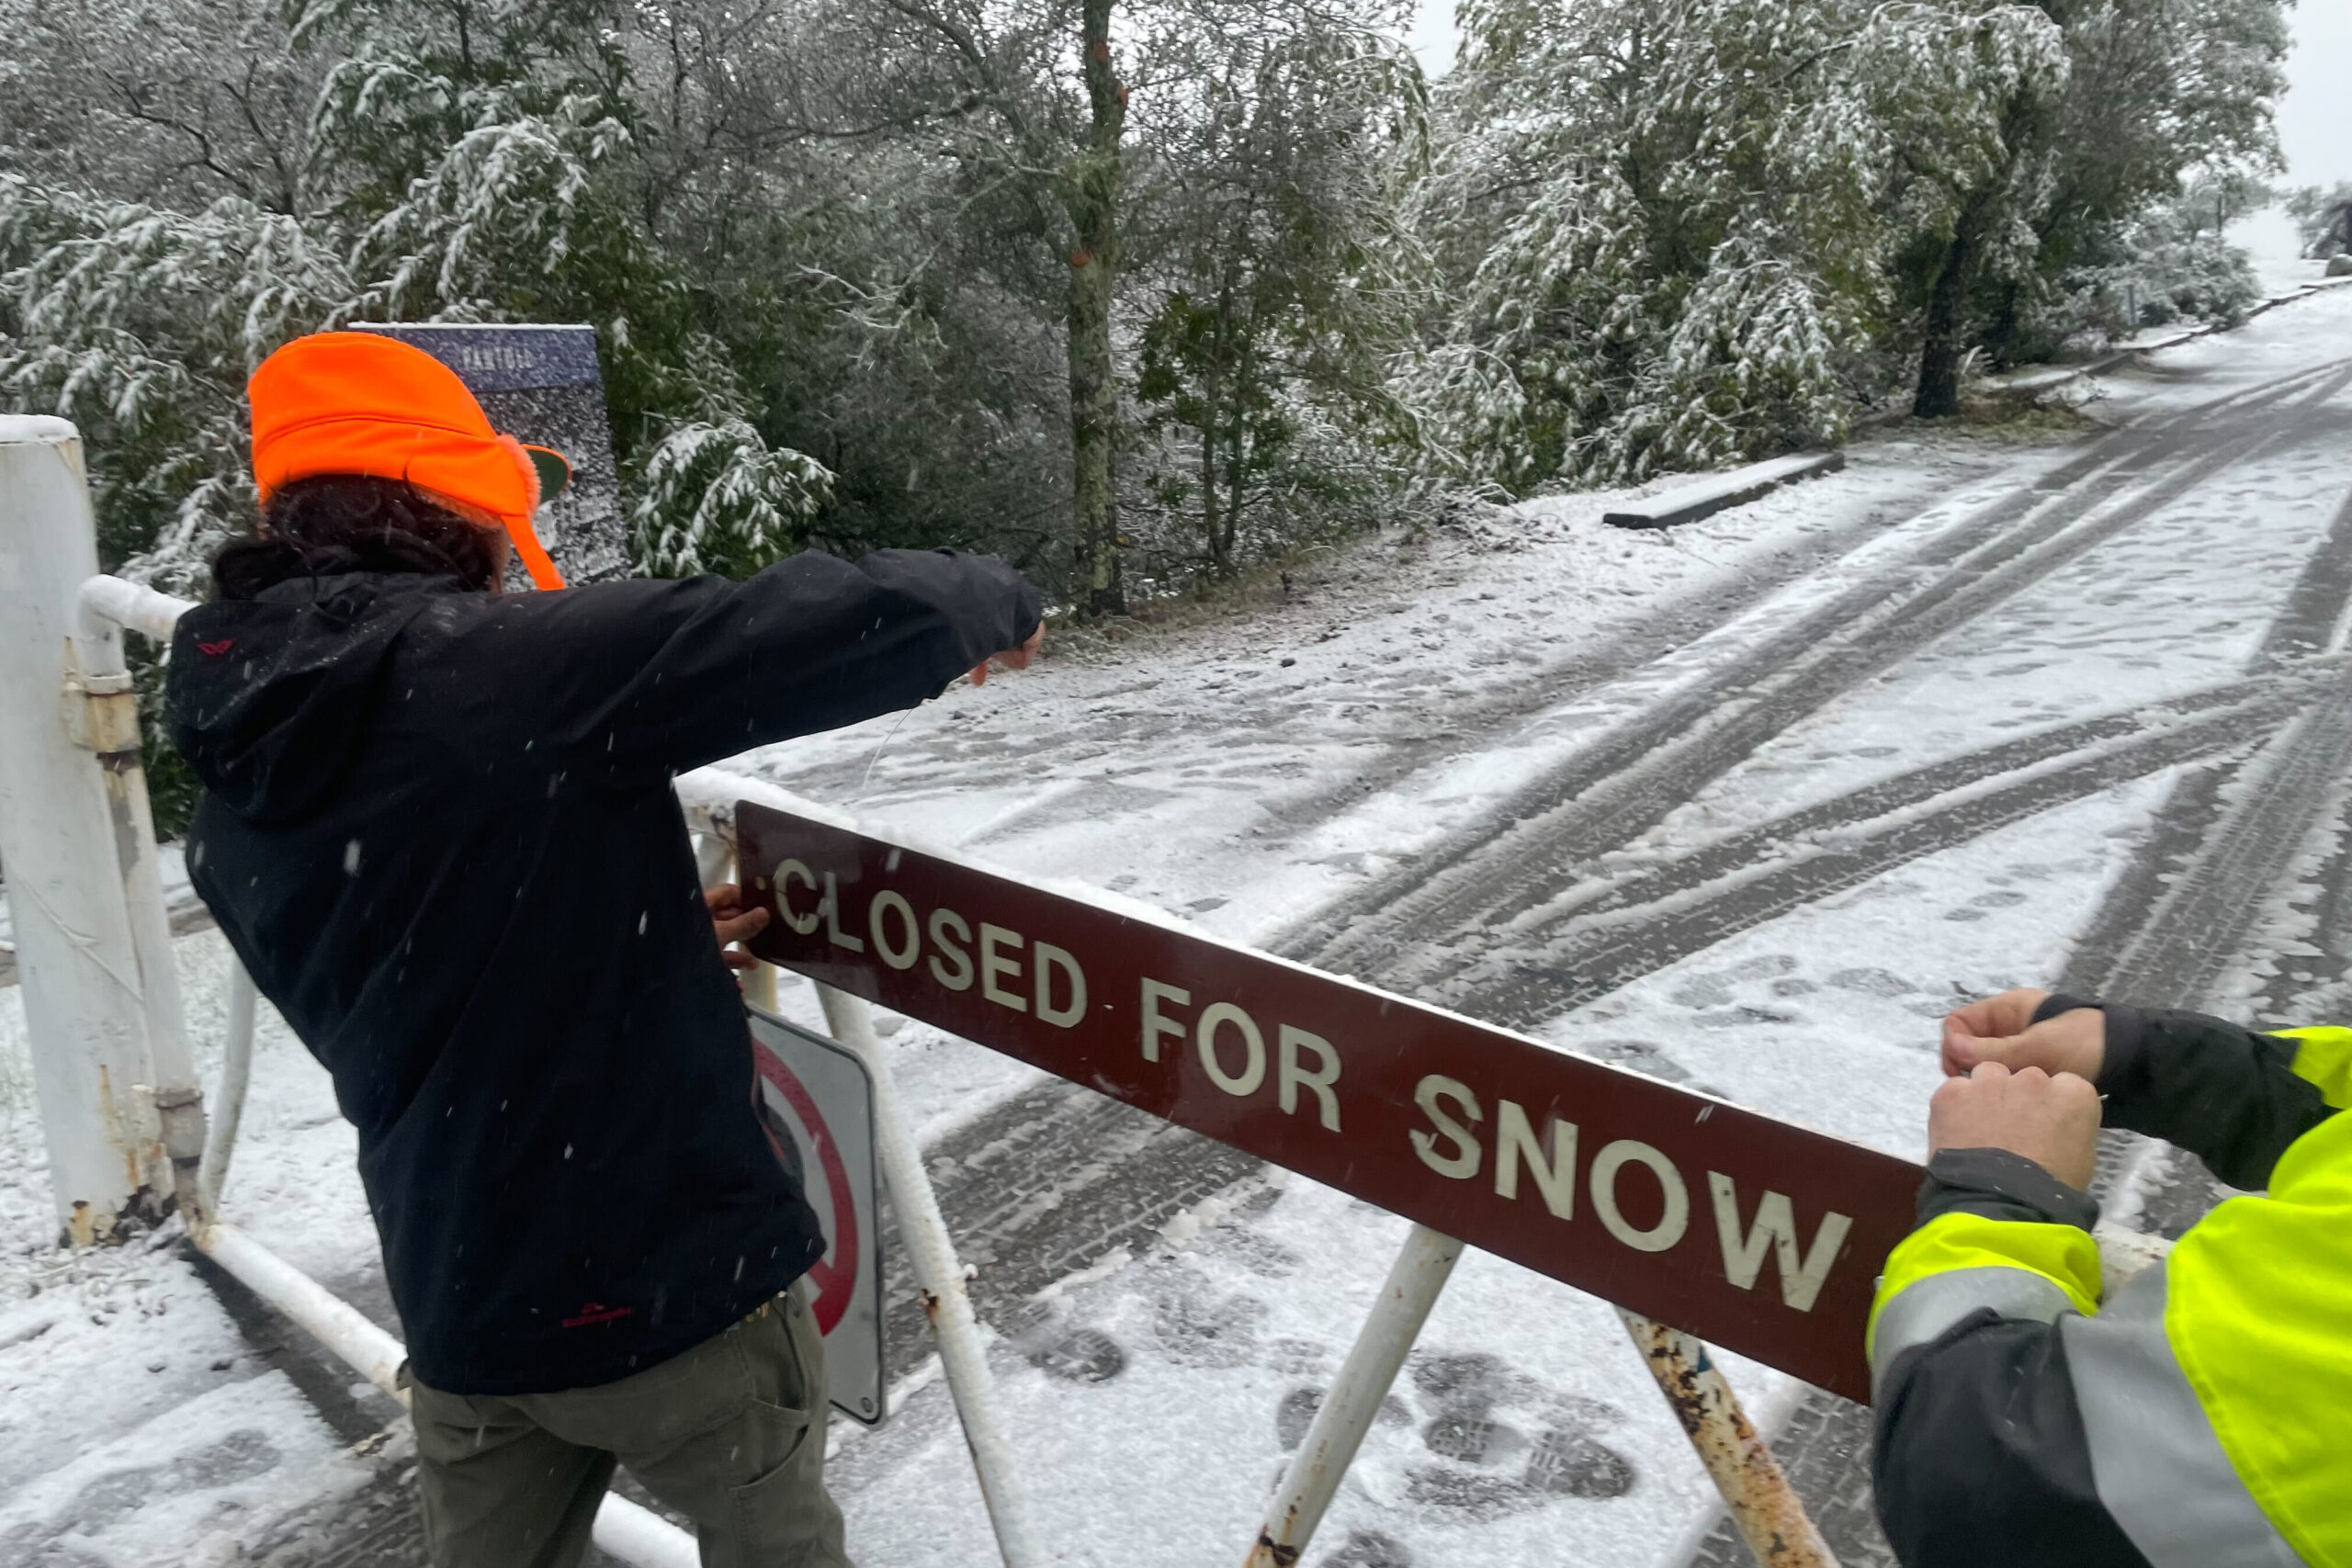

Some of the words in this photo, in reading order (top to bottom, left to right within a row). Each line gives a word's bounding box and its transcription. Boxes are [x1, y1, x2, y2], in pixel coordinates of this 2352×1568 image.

[775, 858, 1089, 1029] CLOSED
[1141, 976, 1342, 1134] FOR
[1408, 1073, 1854, 1313] SNOW
